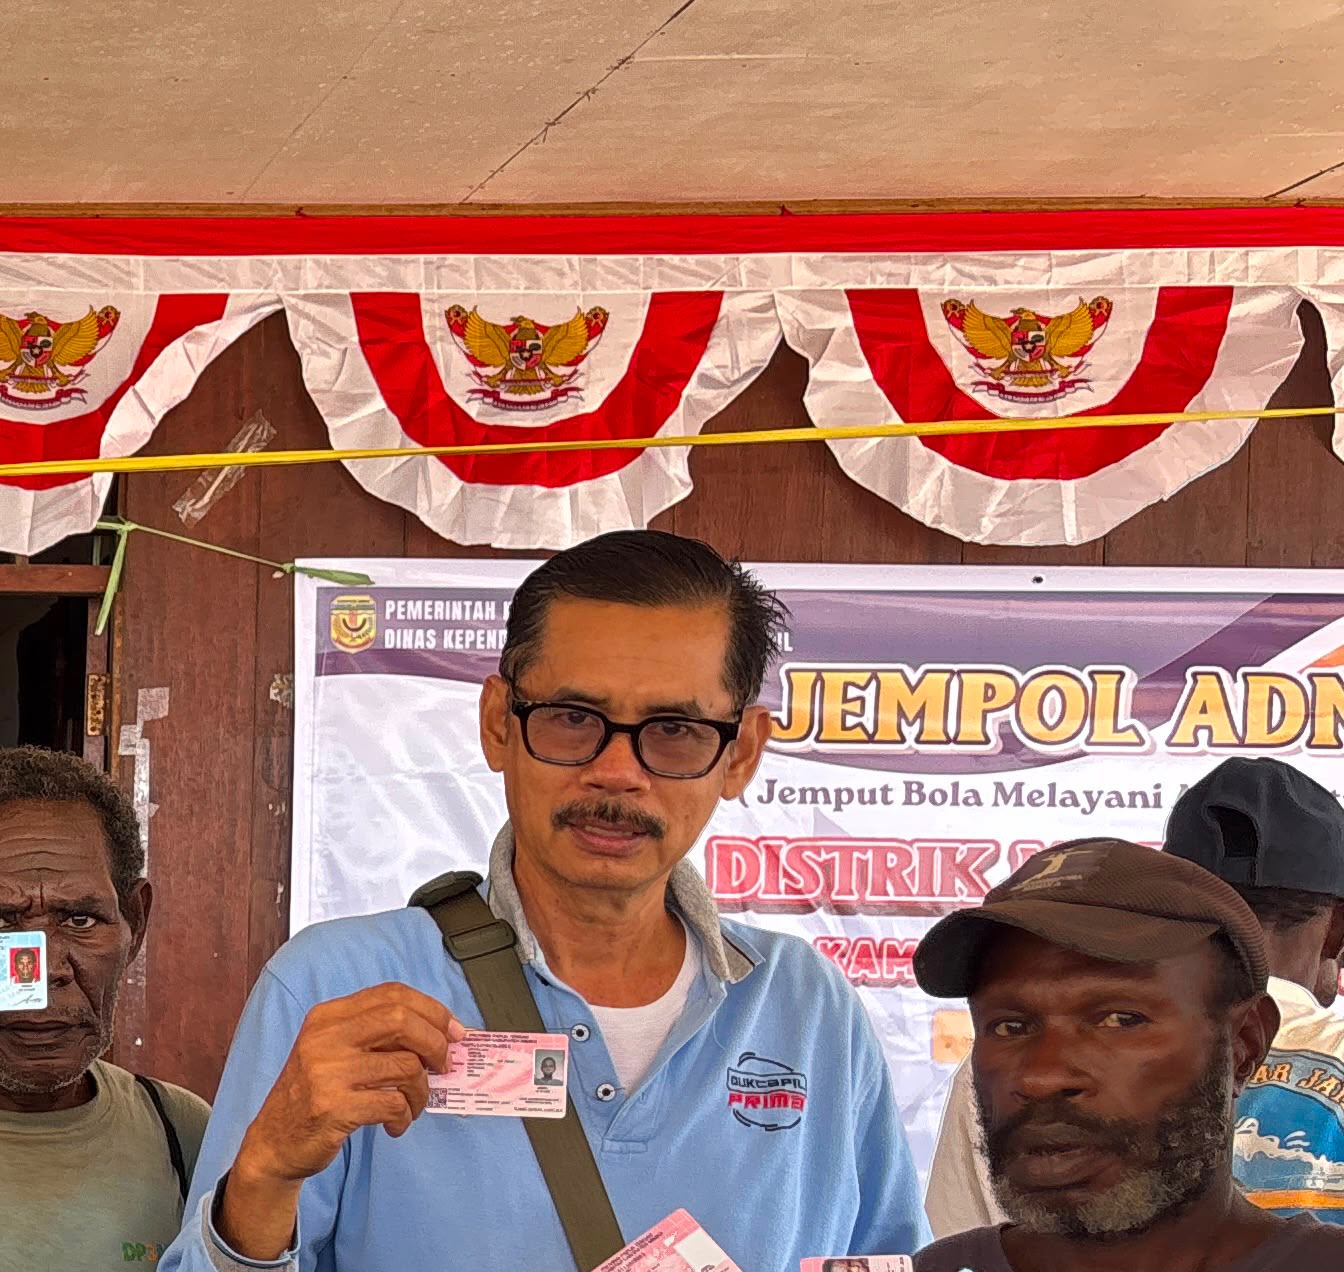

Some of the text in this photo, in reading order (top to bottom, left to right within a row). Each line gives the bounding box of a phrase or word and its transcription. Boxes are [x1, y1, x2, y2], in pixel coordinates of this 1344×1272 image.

[385, 600, 496, 620] PEMERINTAH
[384, 629, 437, 649] DINAS
[443, 629, 509, 650] KEPEND
[770, 667, 1147, 748] JEMPOL
[757, 778, 893, 812] Jemput
[902, 780, 983, 807] Bola
[992, 781, 1162, 815] Melayani
[709, 838, 999, 902] DISTRIK
